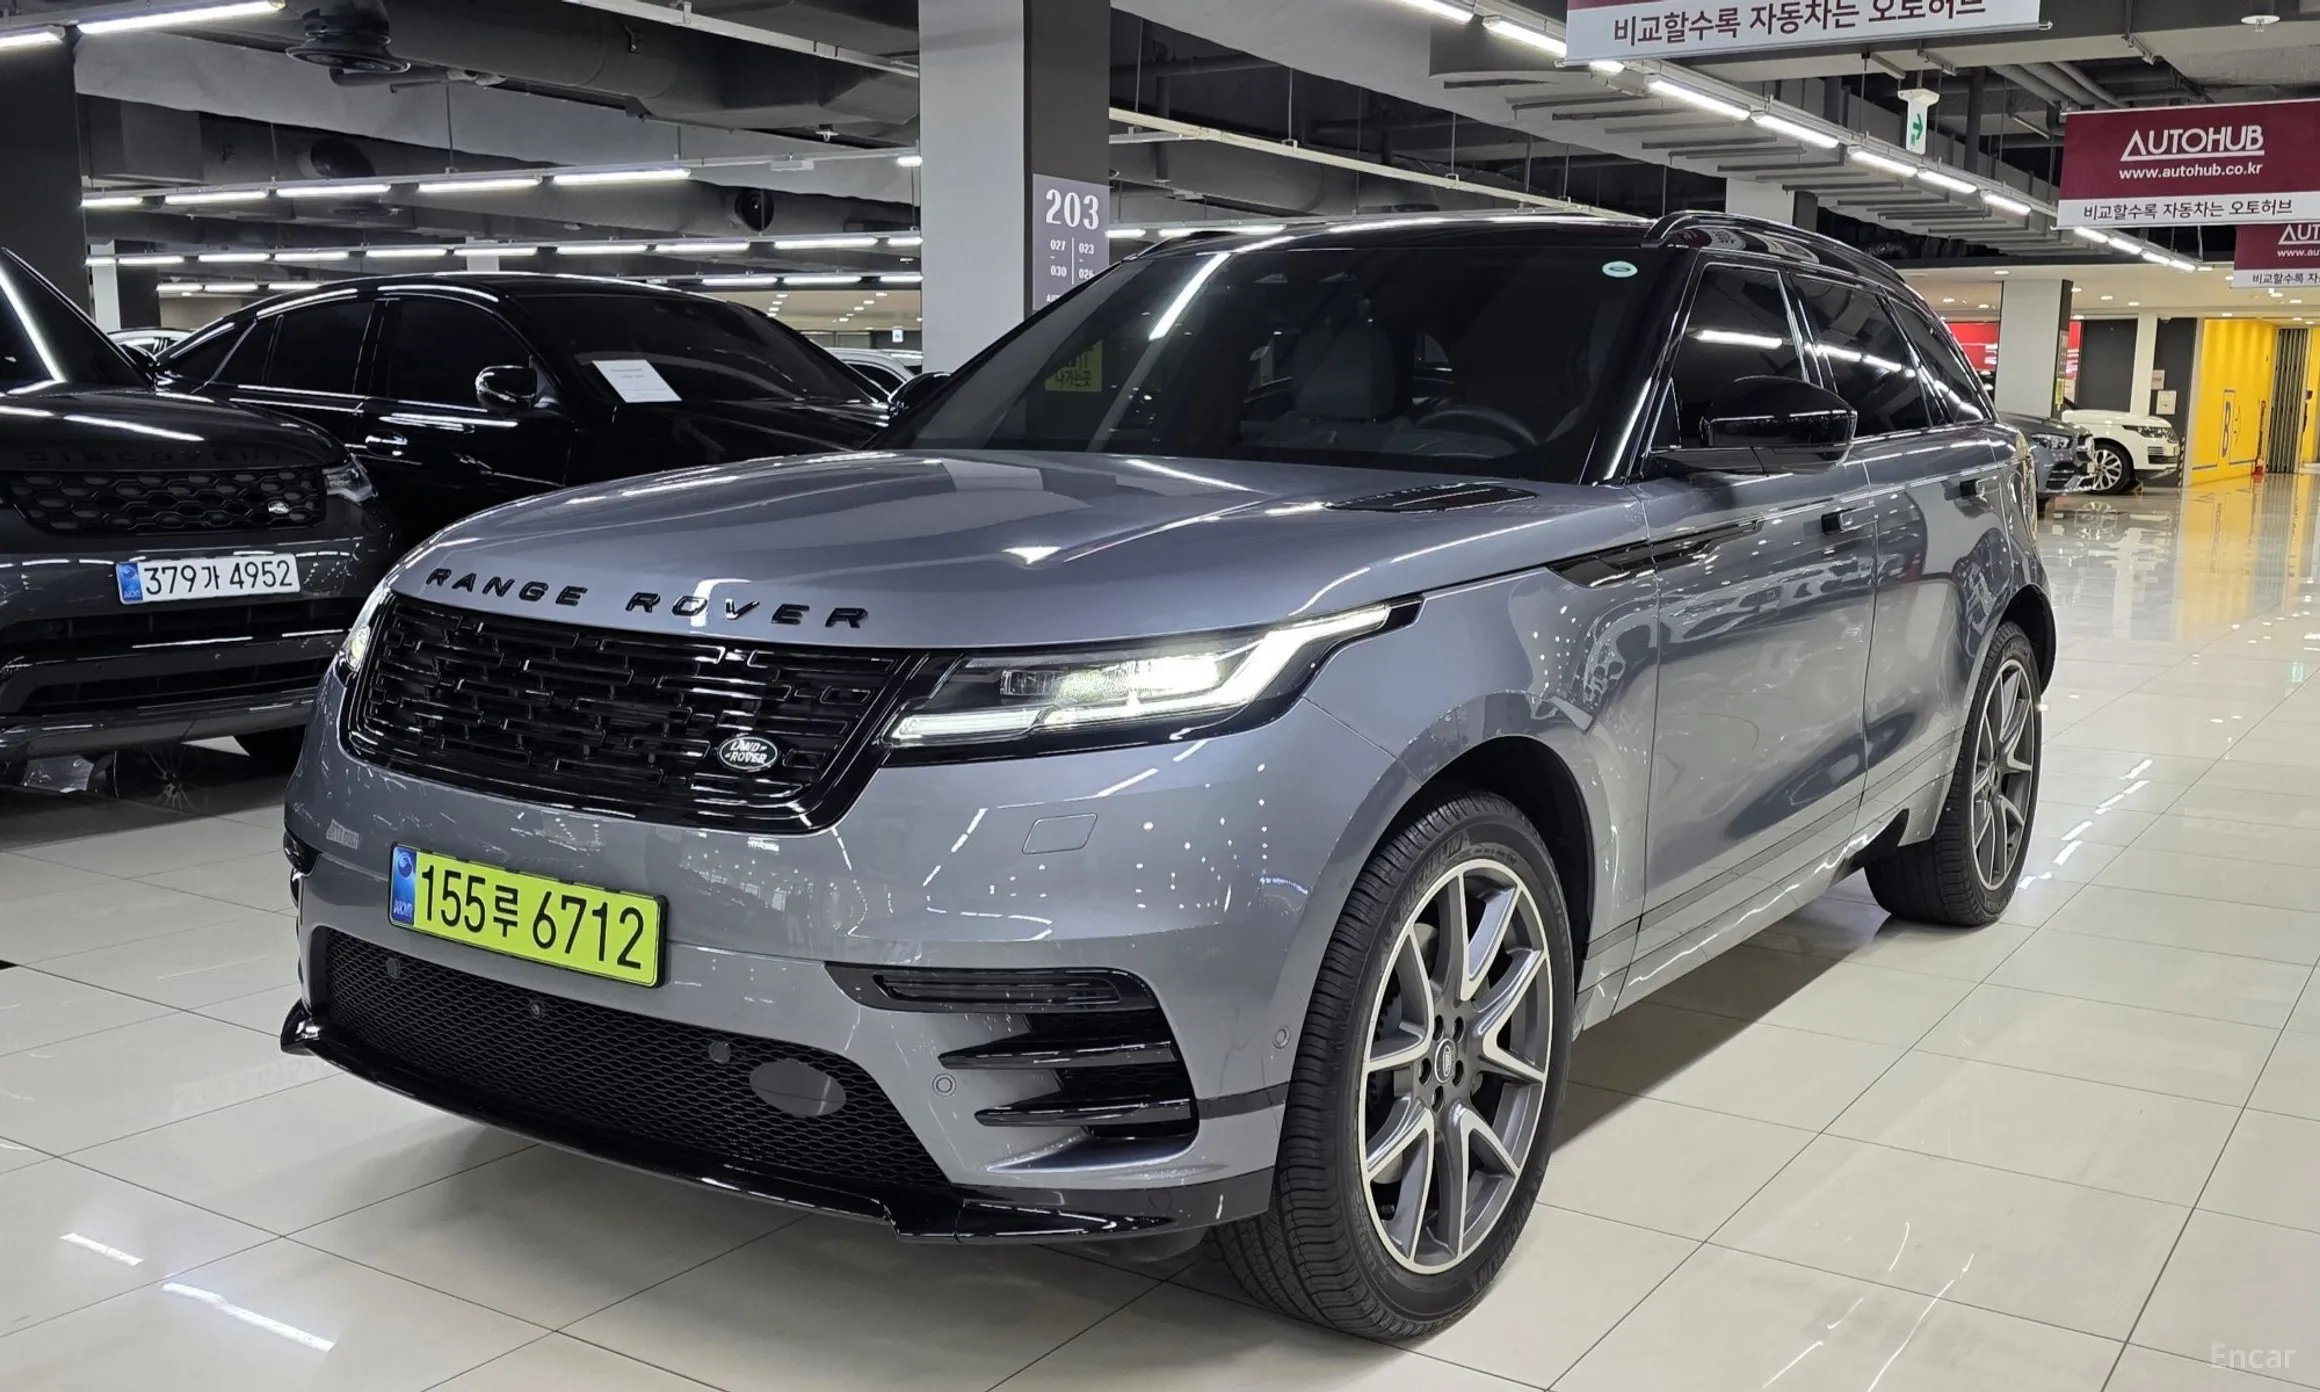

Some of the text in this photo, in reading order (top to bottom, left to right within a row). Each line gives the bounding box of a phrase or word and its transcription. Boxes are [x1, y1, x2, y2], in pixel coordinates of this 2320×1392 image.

[1614, 7, 1741, 47] 비교할수록
[1750, 0, 1859, 34] 자동차는
[2120, 125, 2265, 162] AUTOHUB
[2119, 162, 2263, 180] www.autohub.co.kr
[1046, 188, 1099, 230] 203
[2084, 199, 2293, 221] 비교할수록 자동차는 오토허브
[1050, 239, 1066, 251] 027
[1078, 243, 1095, 255] 023
[1050, 265, 1067, 277] 030
[143, 559, 293, 595] 379가 4952
[425, 567, 869, 629] RANGE ROVER
[422, 864, 642, 970] 155루 6712
